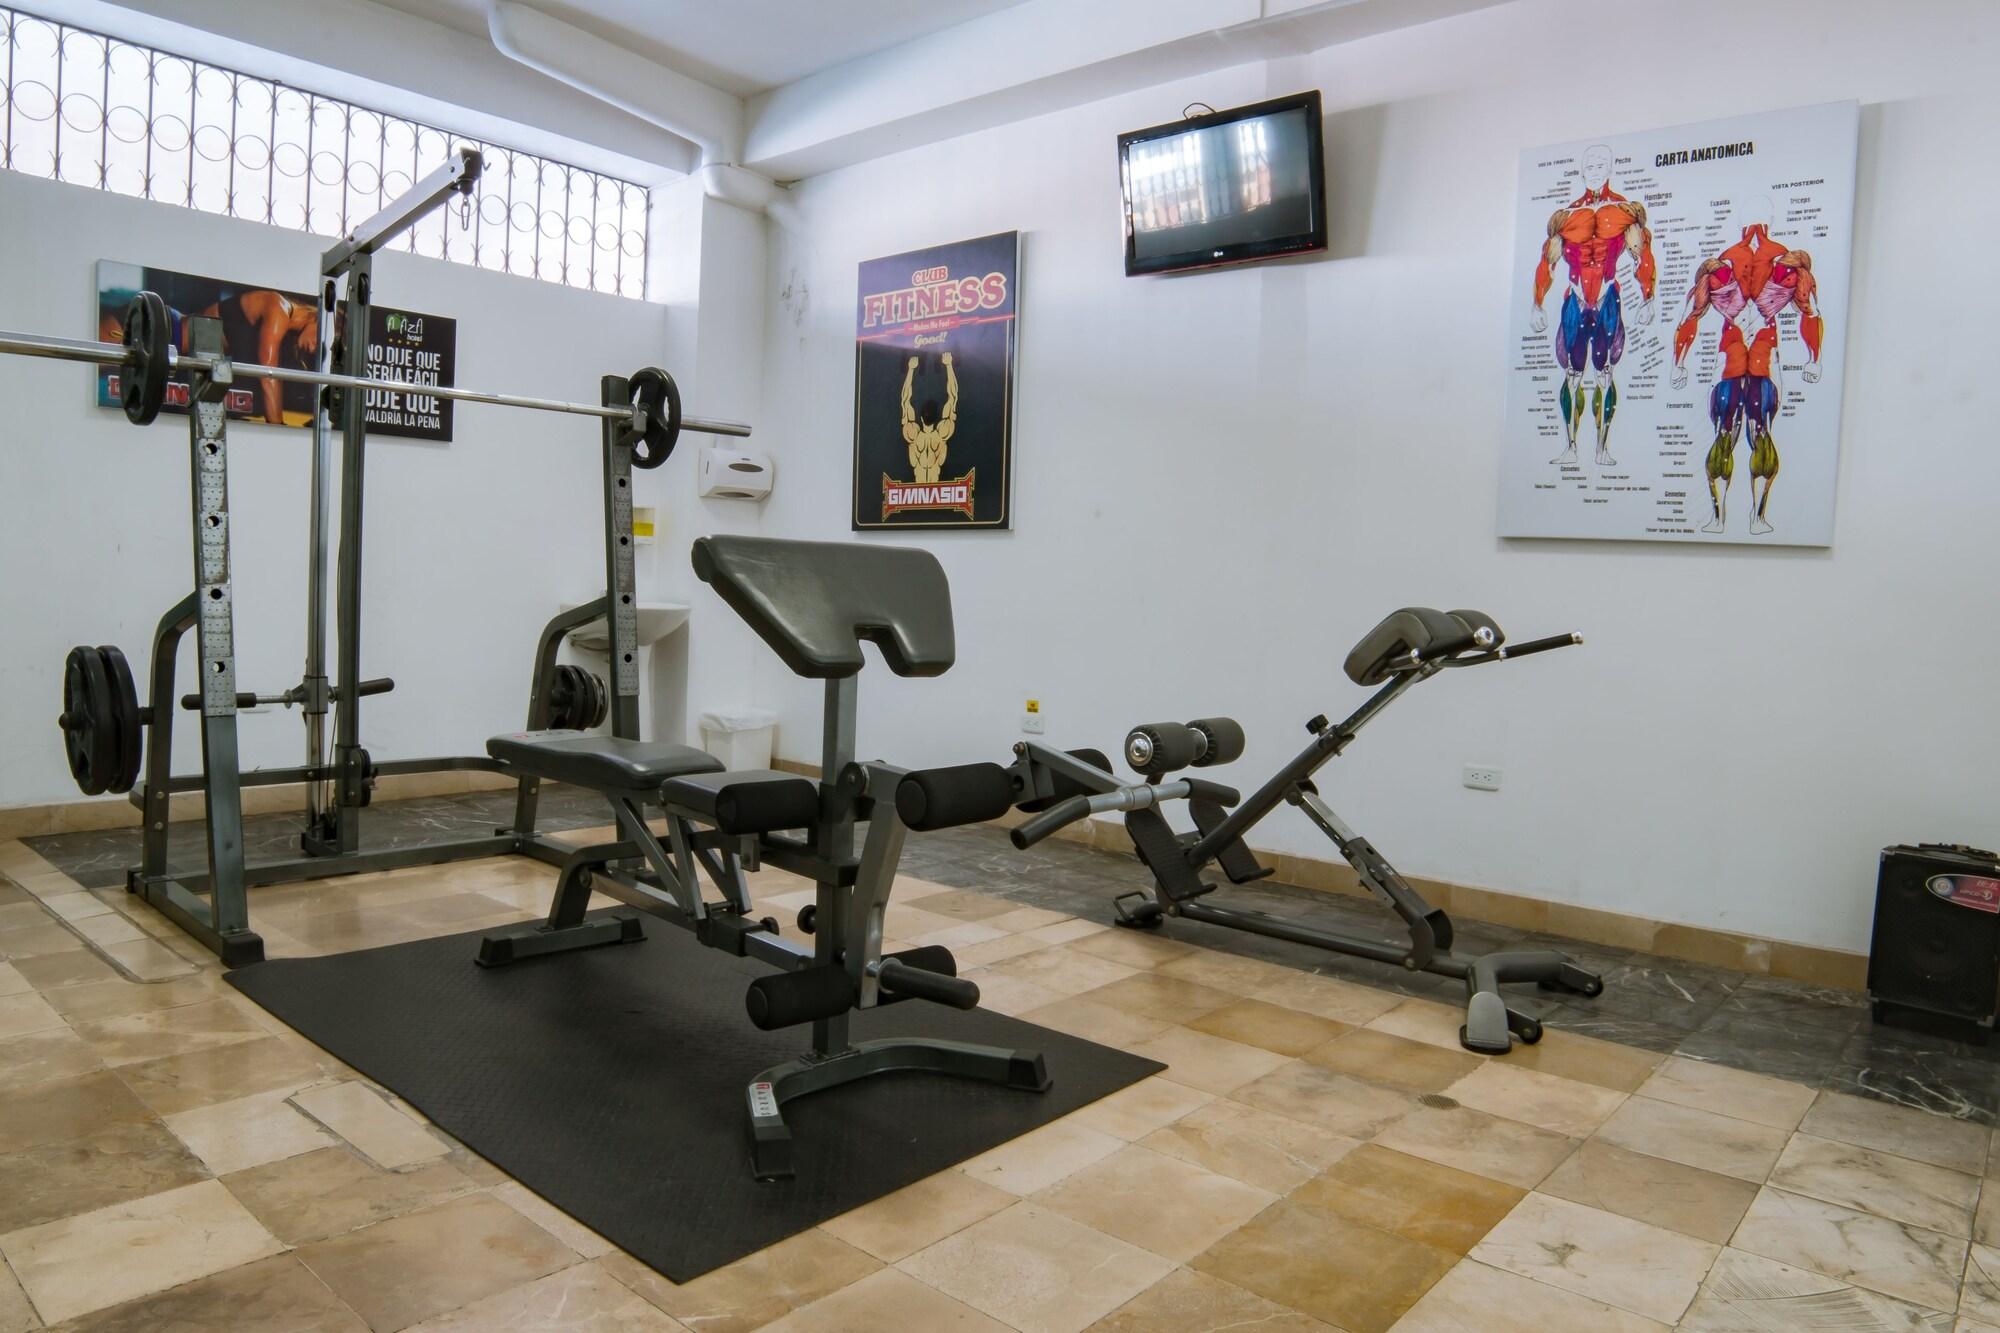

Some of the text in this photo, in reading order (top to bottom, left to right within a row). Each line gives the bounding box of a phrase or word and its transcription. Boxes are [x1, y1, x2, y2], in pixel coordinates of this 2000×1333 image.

[1655, 141, 1754, 168] CARTA ANATOMICA
[1771, 179, 1825, 190] VISTA POSTERIOR
[912, 266, 948, 286] CLUB
[863, 272, 1007, 328] FITNESS
[913, 331, 948, 349] Good!
[367, 344, 441, 371] NO DIJE QUE
[365, 388, 440, 415] DIJE QUE
[404, 413, 416, 427] LA
[417, 415, 441, 430] PENA
[888, 486, 968, 505] GIMNASIO
